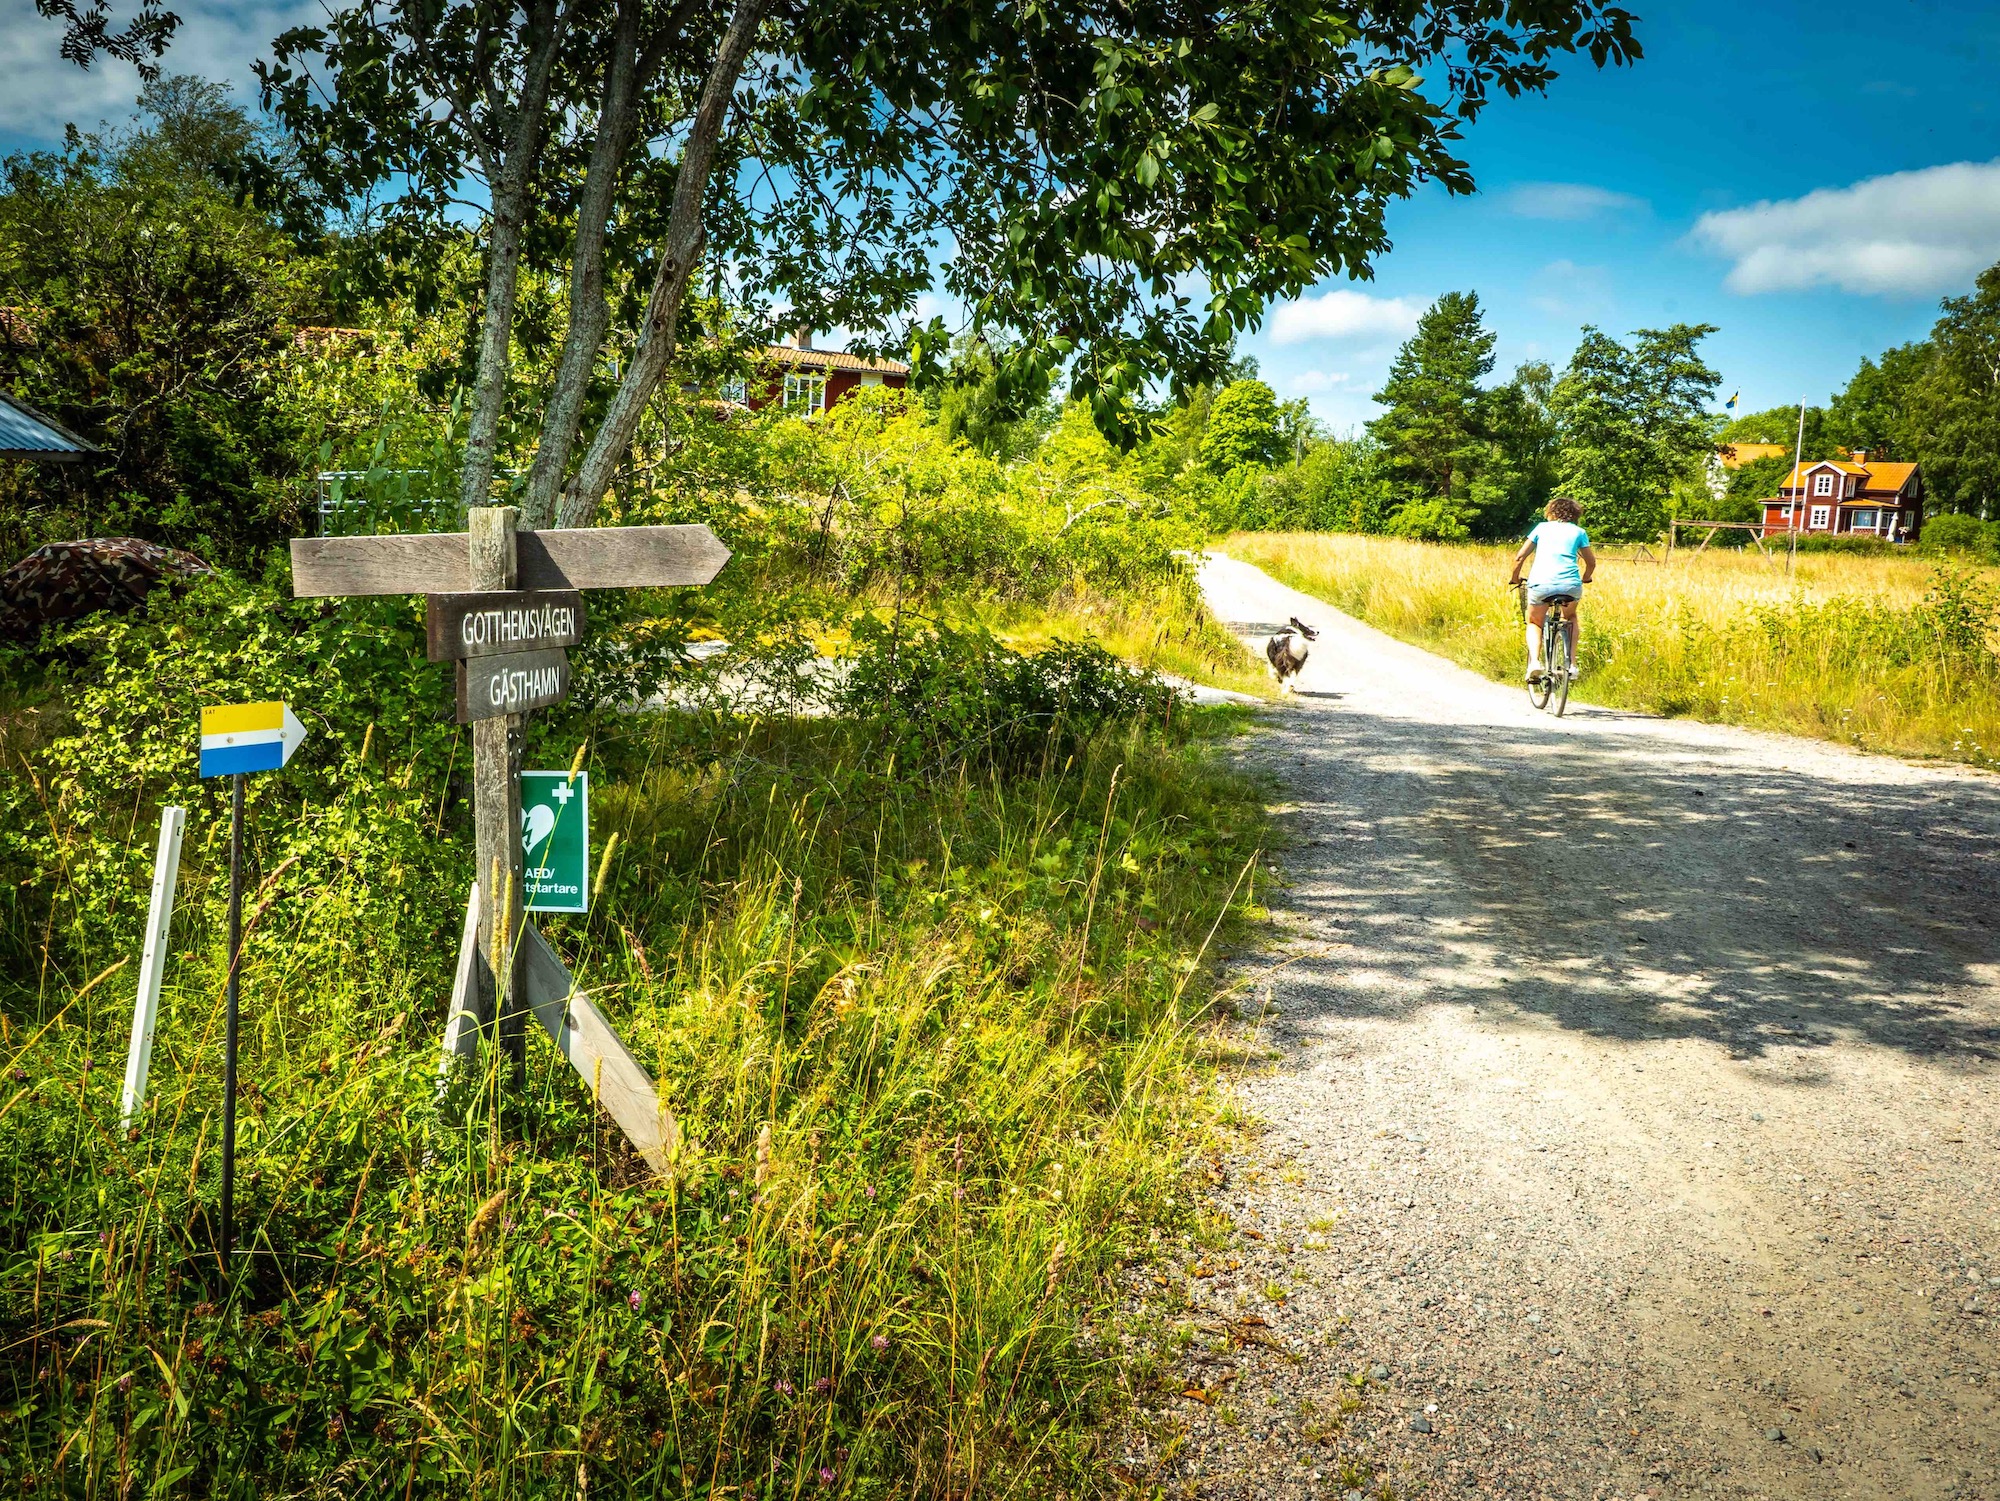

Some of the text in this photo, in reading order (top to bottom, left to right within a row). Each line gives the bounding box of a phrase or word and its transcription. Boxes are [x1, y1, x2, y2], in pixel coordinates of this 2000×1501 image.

[462, 603, 576, 645] GOTTHEMSVÄGEN
[489, 665, 560, 706] GÄSTHAMN
[524, 867, 556, 879] AED/
[523, 882, 579, 895] tstartare
